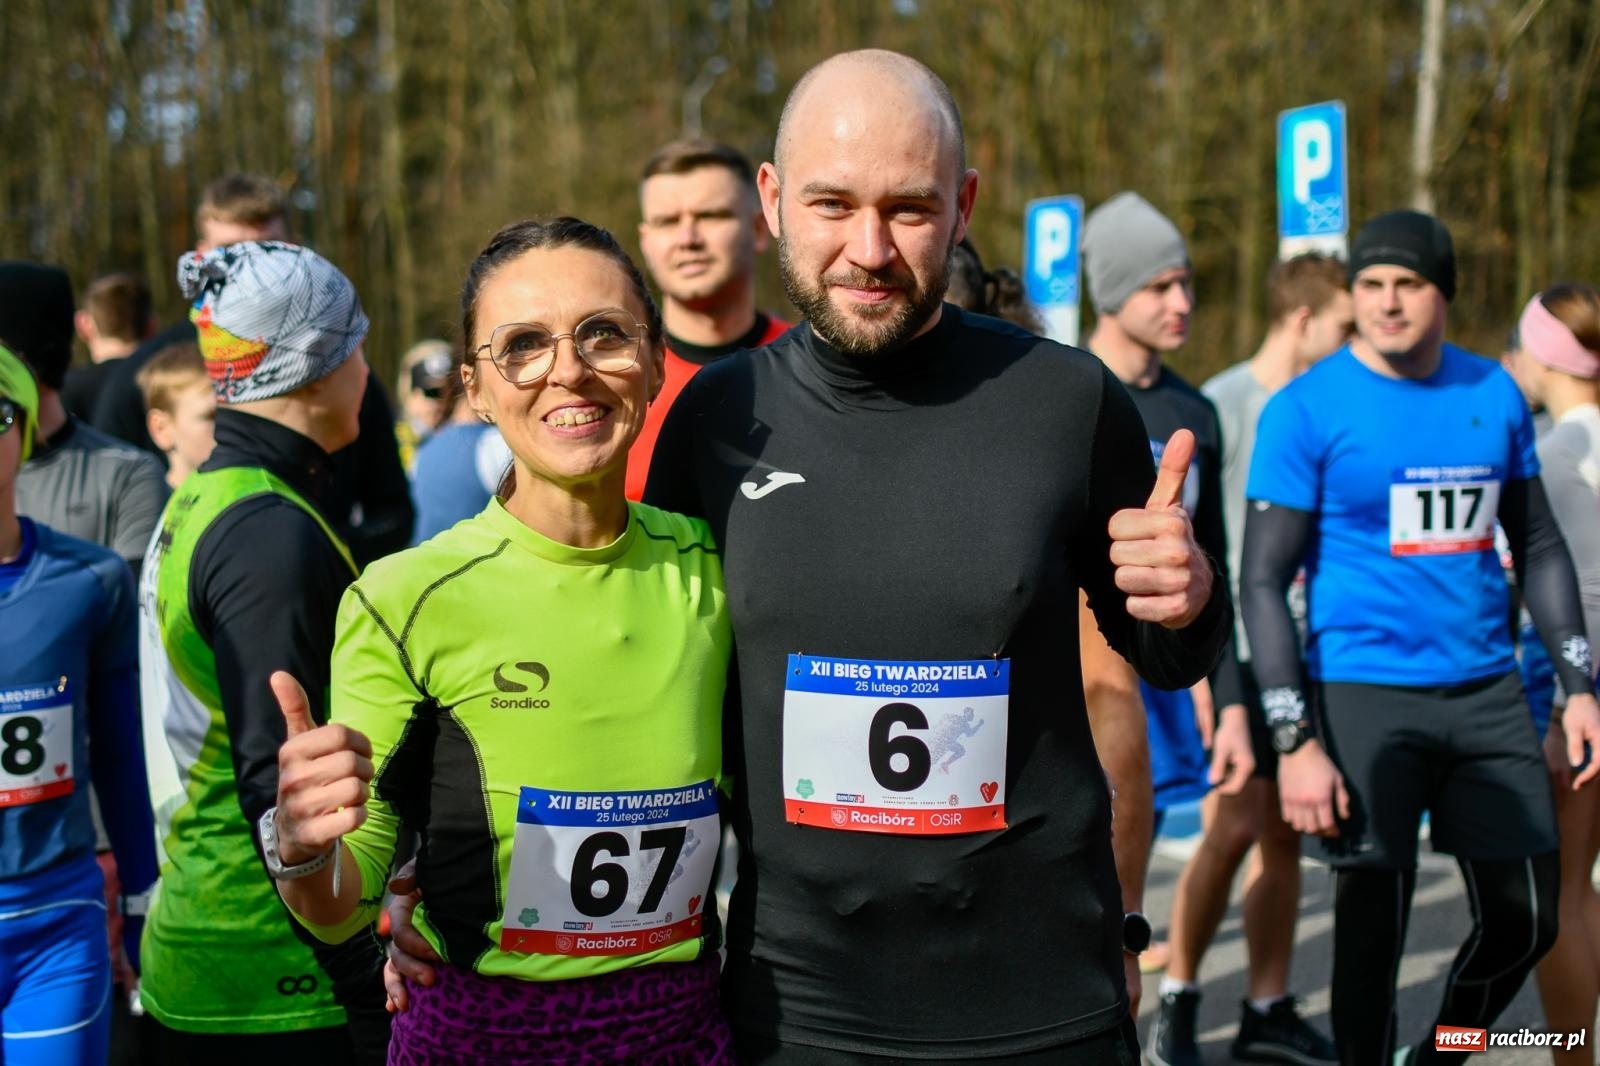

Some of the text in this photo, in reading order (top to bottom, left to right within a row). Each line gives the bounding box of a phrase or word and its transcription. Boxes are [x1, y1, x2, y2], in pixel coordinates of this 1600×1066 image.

[1294, 120, 1331, 204] P
[1035, 208, 1071, 280] P
[1416, 487, 1483, 531] 117
[810, 661, 987, 681] XII BIEG TWARDZIELA
[855, 681, 939, 696] 25 lutego 2024
[490, 697, 550, 709] Sondico
[1, 716, 46, 776] 8
[868, 702, 931, 792] 6
[548, 787, 705, 810] XII BIEG TWARDZIELA
[596, 808, 669, 824] 25 lutego 2024
[851, 811, 915, 826] Racibórz
[930, 813, 962, 827] OSiR
[570, 826, 687, 917] 67
[576, 936, 637, 950] Racibórz
[649, 928, 673, 945] OSiR
